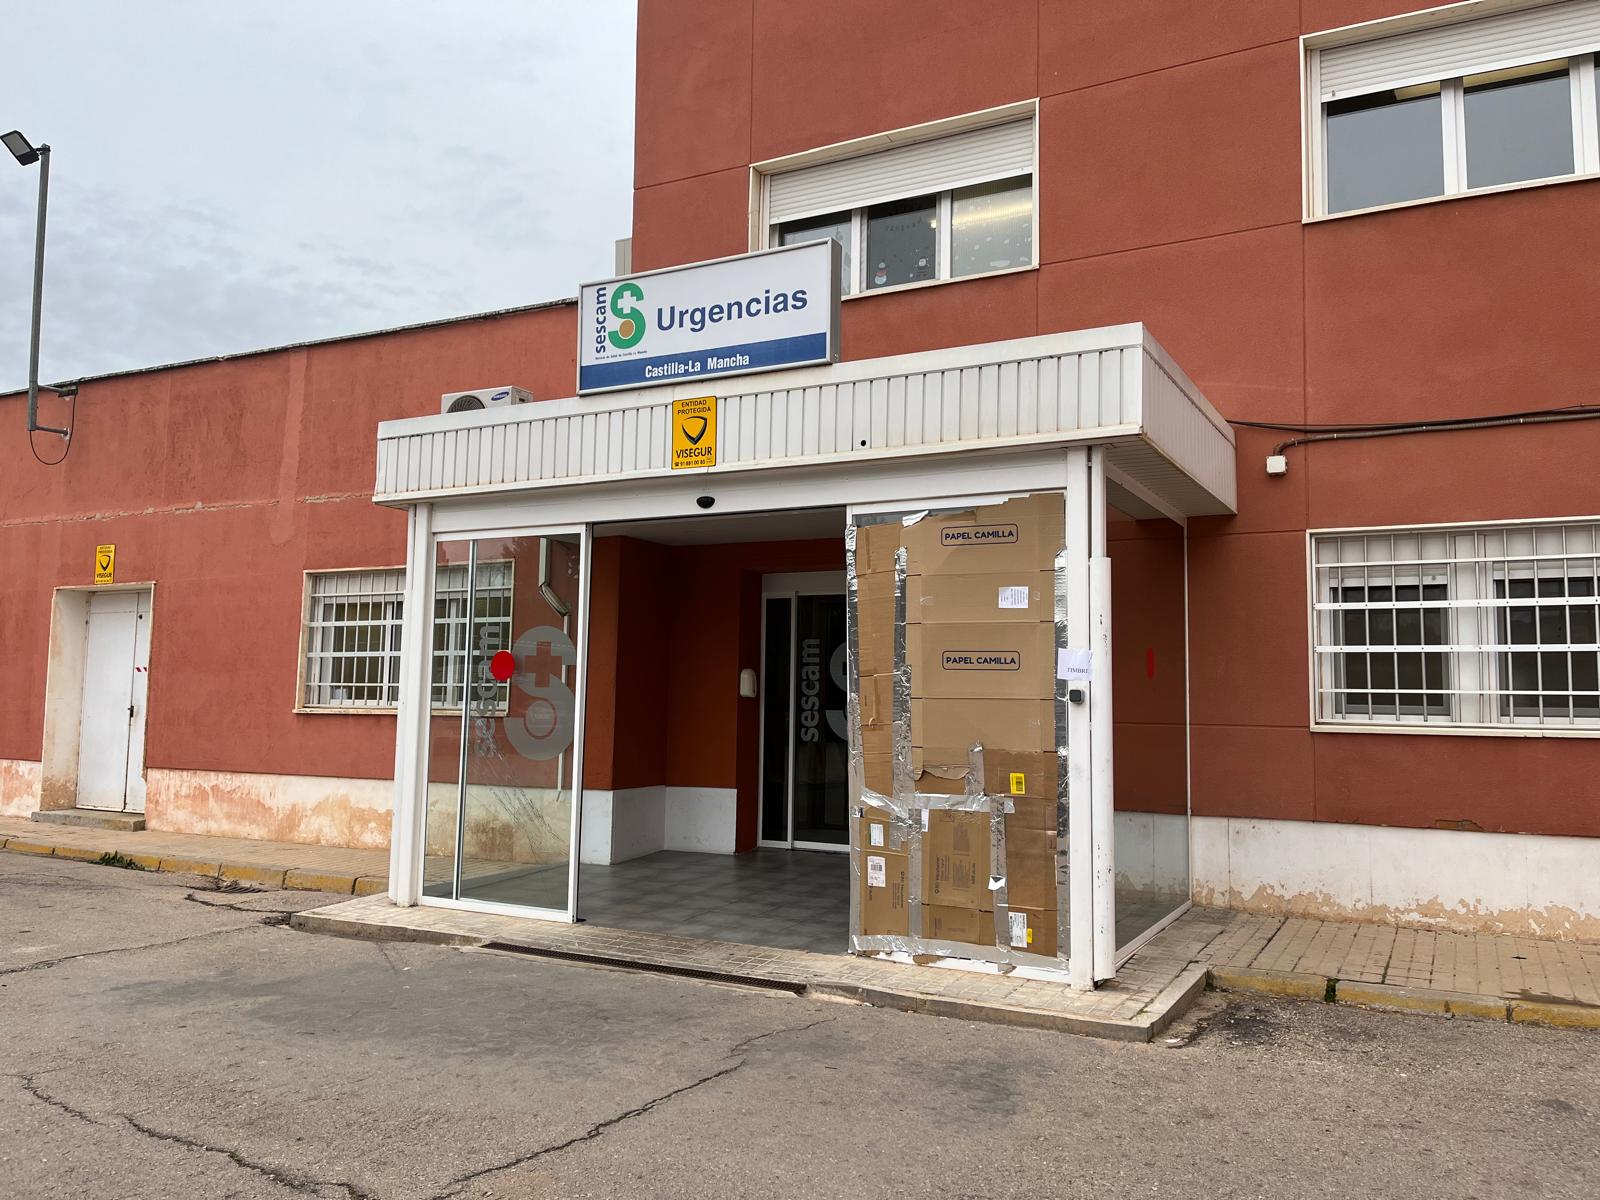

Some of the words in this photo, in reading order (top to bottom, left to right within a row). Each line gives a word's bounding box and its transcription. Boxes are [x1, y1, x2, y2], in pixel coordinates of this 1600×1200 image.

[657, 289, 808, 333] Urgencias
[595, 287, 607, 354] sescam
[645, 360, 701, 378] Castilla-La
[707, 354, 750, 370] Mancha
[682, 400, 706, 408] ENTIDAD
[678, 407, 711, 415] PROTEGIDA
[675, 446, 713, 459] VISEGUR
[944, 532, 972, 541] PAPEL
[974, 530, 1015, 539] CAMILLA
[946, 656, 975, 665] PAPEL
[976, 656, 1017, 665] CAMILLA
[800, 638, 820, 742] sescam
